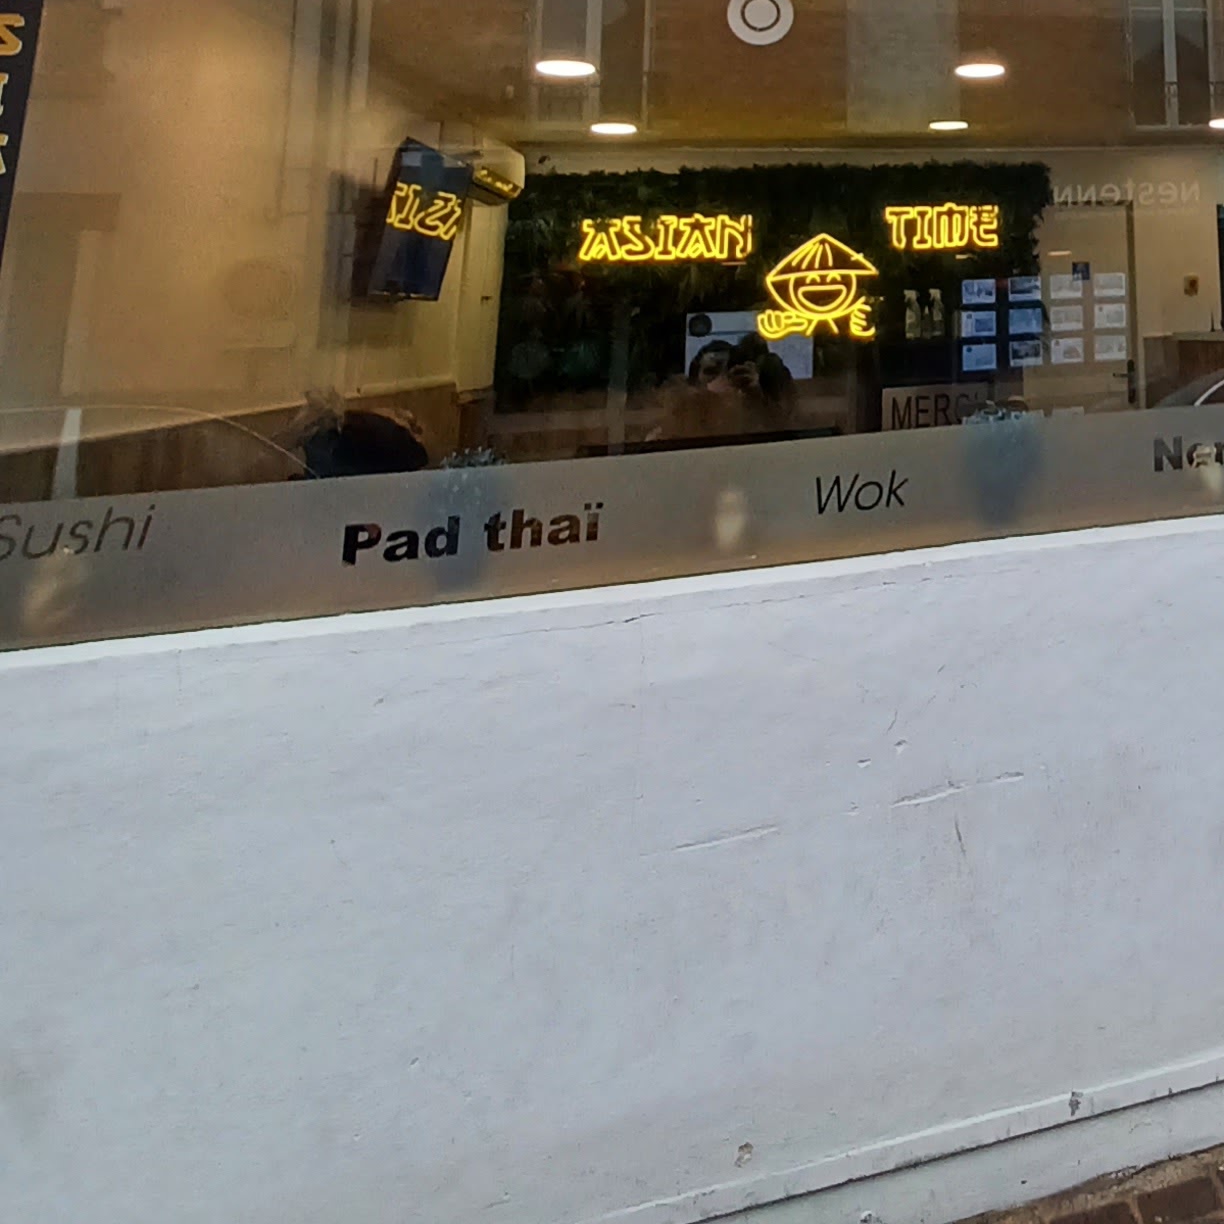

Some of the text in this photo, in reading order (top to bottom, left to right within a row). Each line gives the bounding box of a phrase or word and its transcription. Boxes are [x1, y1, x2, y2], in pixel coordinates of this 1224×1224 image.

[578, 202, 1000, 262] ASIAN TIME
[815, 470, 909, 516] Wok
[0, 504, 156, 562] Sushi
[341, 503, 604, 566] Pad thaï
